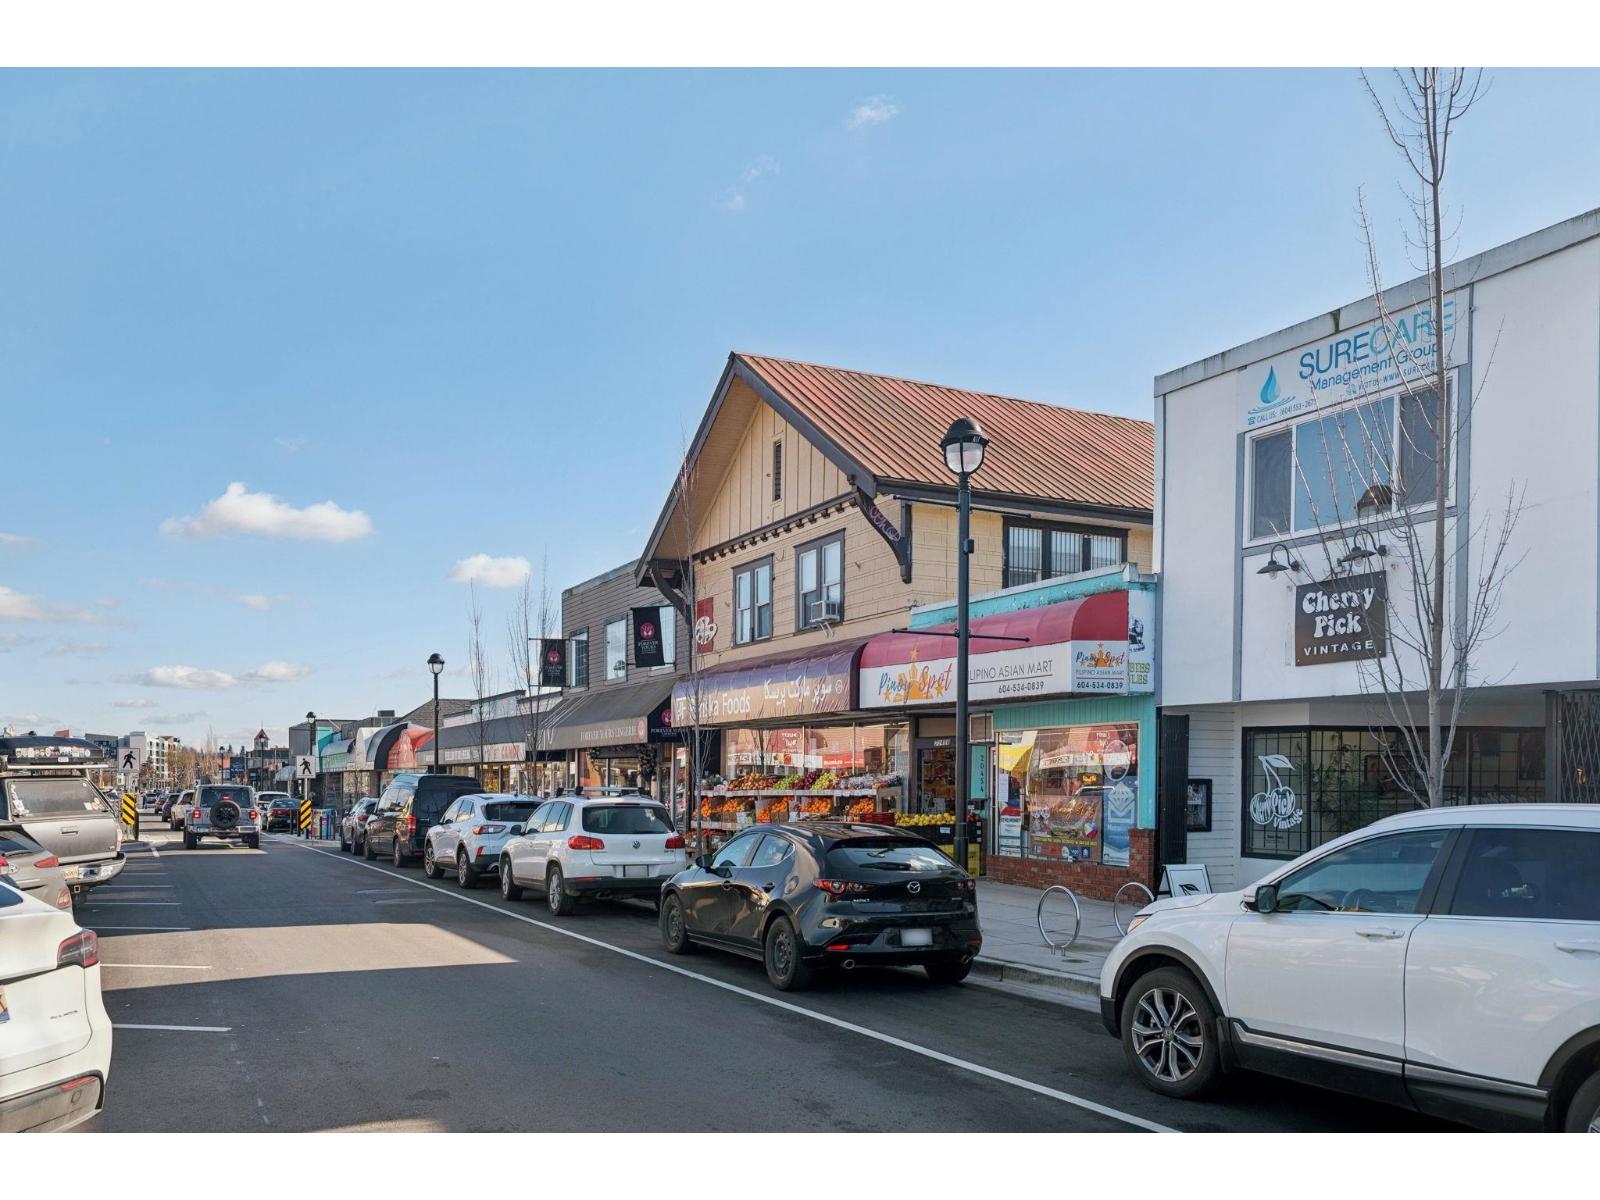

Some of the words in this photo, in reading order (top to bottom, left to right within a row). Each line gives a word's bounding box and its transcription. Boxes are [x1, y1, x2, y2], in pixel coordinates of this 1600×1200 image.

[1311, 355, 1392, 391] Management
[1302, 587, 1375, 614] Cherry
[1313, 612, 1362, 638] Pick
[1304, 640, 1374, 656] VINTAGE
[967, 666, 996, 681] LIPINO
[999, 663, 1025, 678] ASIAN
[1027, 659, 1053, 675] MART
[1076, 681, 1124, 690] 604-534-0839
[722, 690, 751, 716] Foods
